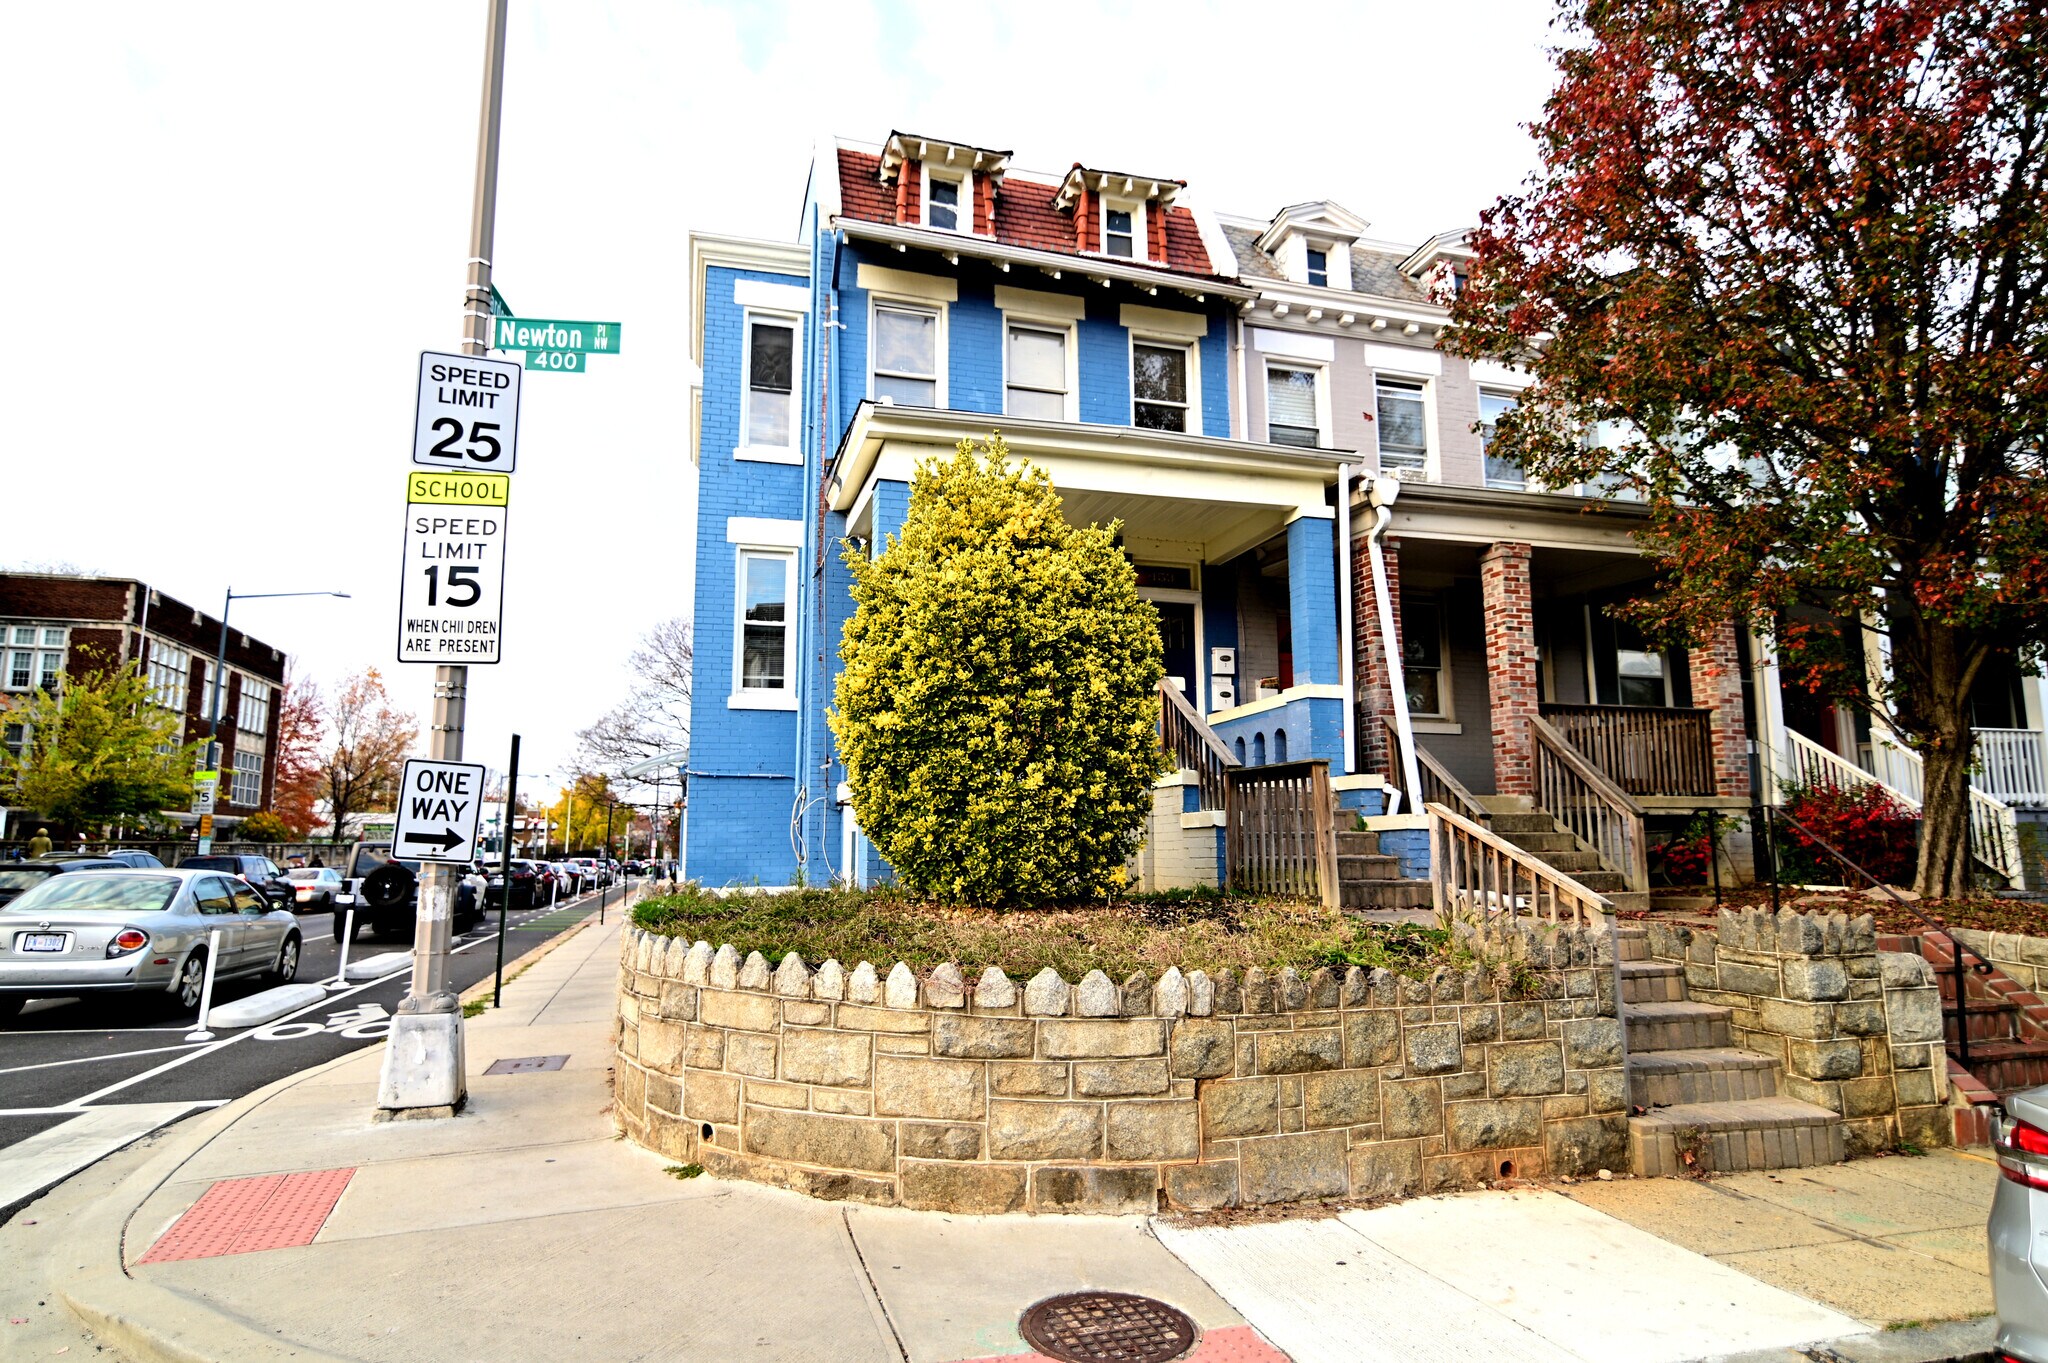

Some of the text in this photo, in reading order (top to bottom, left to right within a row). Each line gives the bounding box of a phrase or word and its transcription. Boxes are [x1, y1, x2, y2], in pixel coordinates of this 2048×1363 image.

[501, 320, 582, 349] Newton
[594, 336, 608, 350] NW
[534, 351, 577, 370] 400
[430, 364, 510, 390] SPEED
[438, 387, 500, 409] LIMIT
[429, 417, 502, 463] 25
[415, 480, 503, 500] SCHOOL
[415, 517, 497, 536] SPEED
[422, 542, 488, 560] LIMIT
[424, 565, 482, 608] 15
[407, 619, 439, 633] WHEN
[405, 638, 496, 653] ARE PRESENT
[416, 769, 471, 795] ONE
[412, 797, 469, 822] WAY
